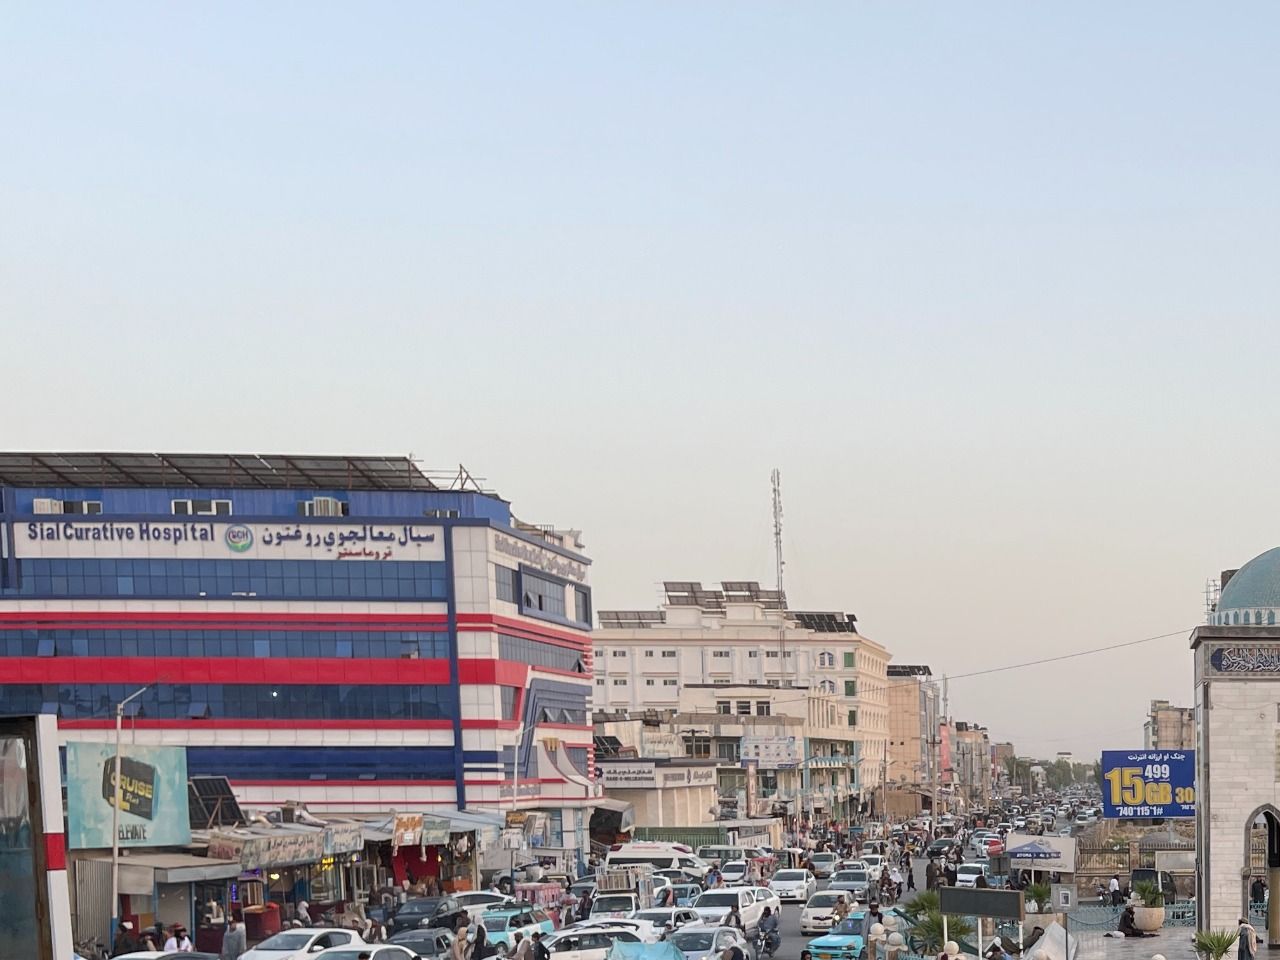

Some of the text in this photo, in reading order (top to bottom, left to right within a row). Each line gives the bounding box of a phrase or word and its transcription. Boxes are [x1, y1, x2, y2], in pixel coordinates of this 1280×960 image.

[28, 523, 215, 545] Sial Curative Hospital
[1145, 765, 1170, 778] 499
[110, 771, 153, 799] CRUISE
